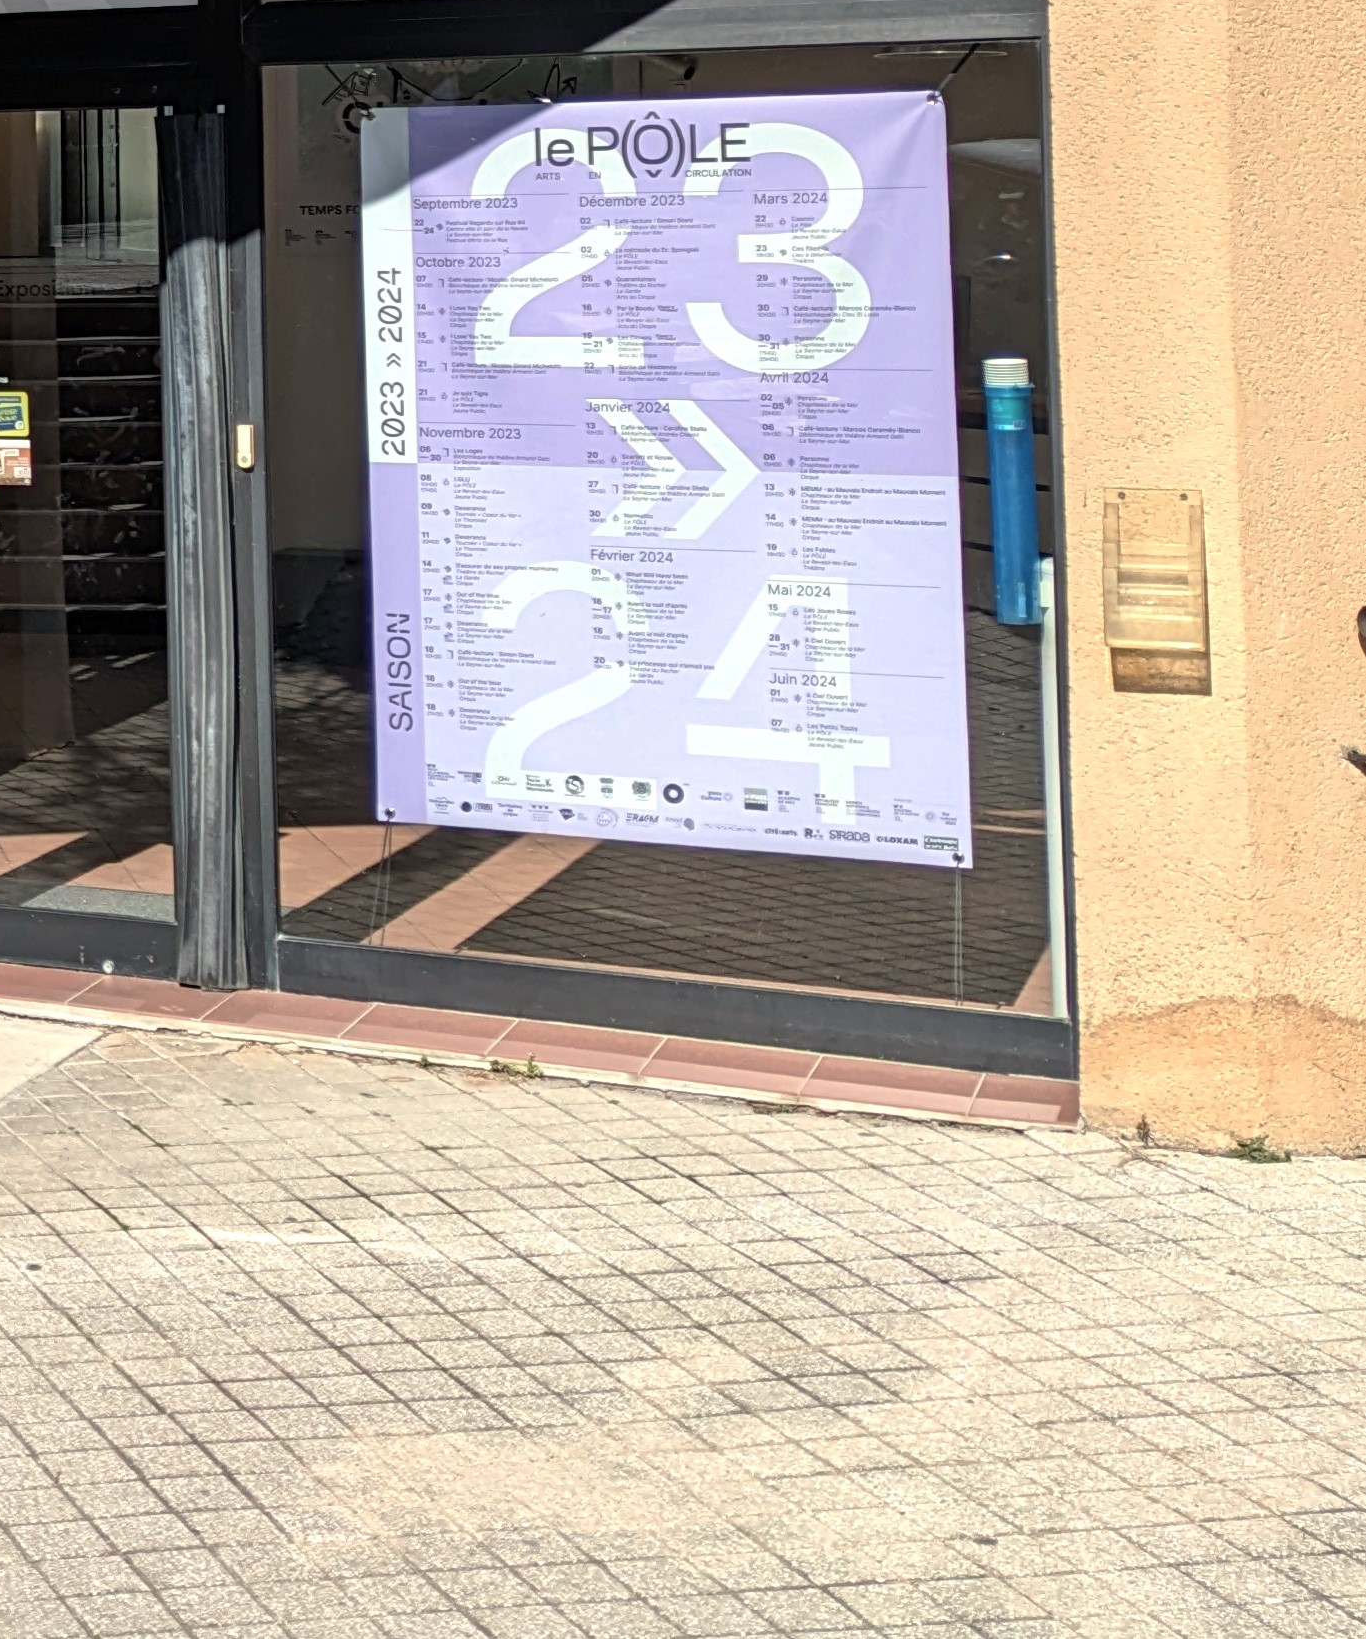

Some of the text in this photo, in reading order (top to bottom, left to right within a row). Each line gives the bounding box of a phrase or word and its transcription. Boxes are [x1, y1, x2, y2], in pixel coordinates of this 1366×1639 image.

[535, 127, 575, 166] le
[589, 172, 601, 180] EN
[685, 169, 751, 177] CIRCULATION
[414, 198, 518, 211] Septembre 2023
[580, 195, 685, 207] Décembre 2023
[754, 193, 828, 204] Mars 2024
[300, 205, 342, 215] TEMPS
[416, 257, 501, 268] Octobre 2023
[377, 267, 402, 344] 2024
[760, 372, 829, 384] Avril 2024
[585, 402, 670, 413] Janvier 2024
[380, 381, 405, 456] 2023
[419, 427, 521, 439] Novembre 2023
[591, 549, 673, 563] Février 2024
[768, 584, 831, 597] Mai 2024
[386, 612, 413, 732] SAISON
[769, 673, 837, 687] Juin 2024
